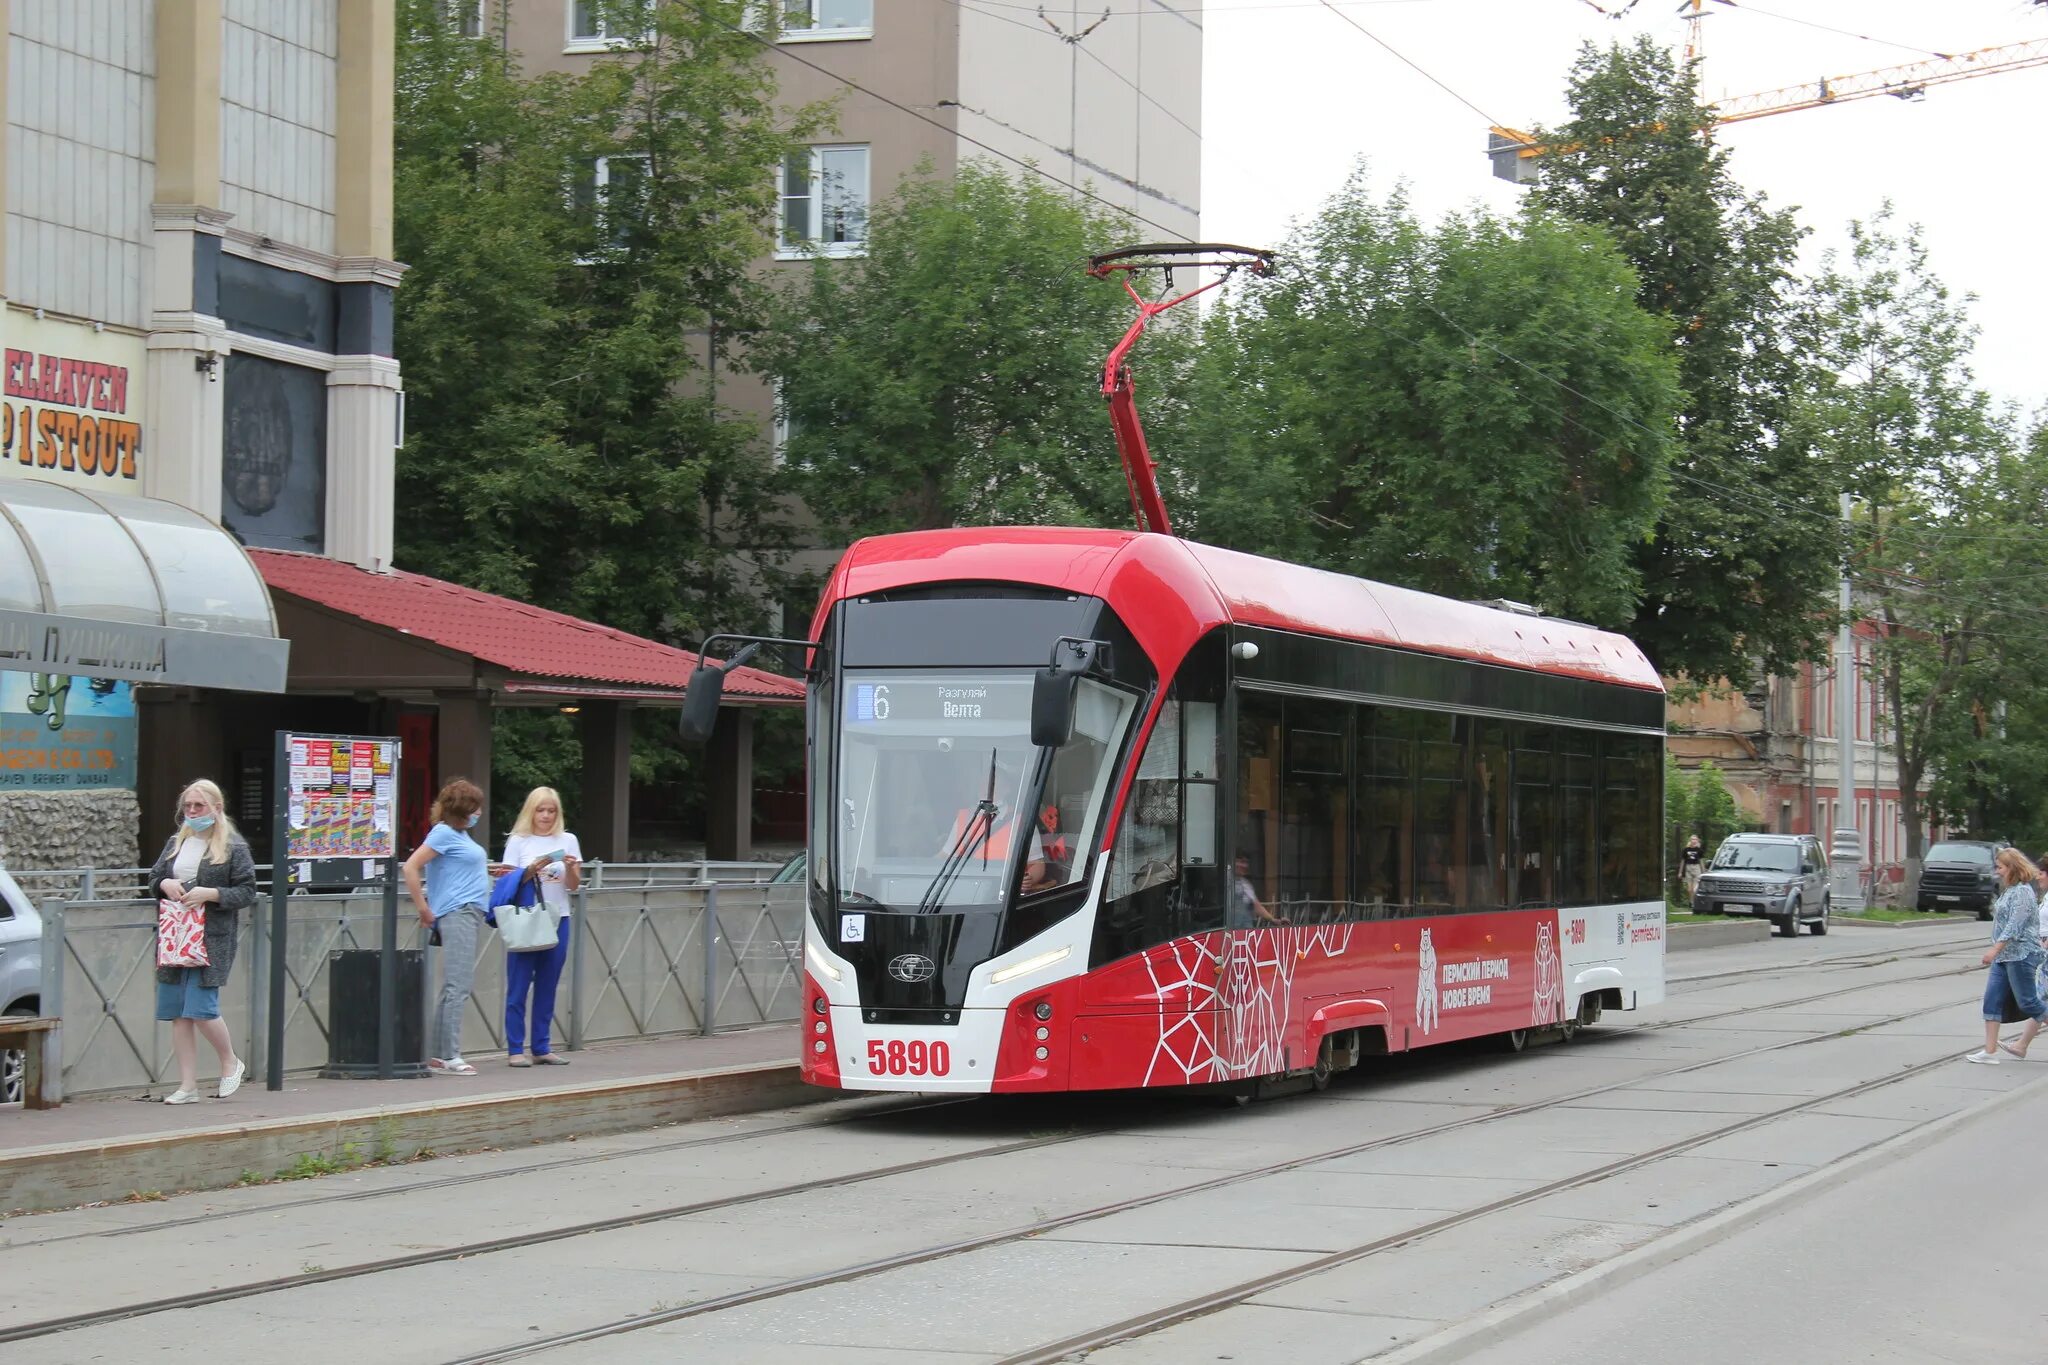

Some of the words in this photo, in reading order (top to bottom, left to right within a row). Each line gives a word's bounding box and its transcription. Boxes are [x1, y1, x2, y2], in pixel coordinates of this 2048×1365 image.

[4, 347, 129, 414] ELHAVEN
[37, 408, 142, 479] STOUT
[938, 686, 987, 699] Разгуляй
[943, 701, 981, 718] Велта
[1631, 924, 1661, 945] permfest.ru
[1443, 957, 1480, 984] ПЕРМСКИЙ
[1482, 959, 1509, 980] ПЕРИОД
[1443, 988, 1466, 1010] НОВОЕ
[1467, 985, 1491, 1006] ВРЕМЯ
[867, 1040, 950, 1077] 5890
